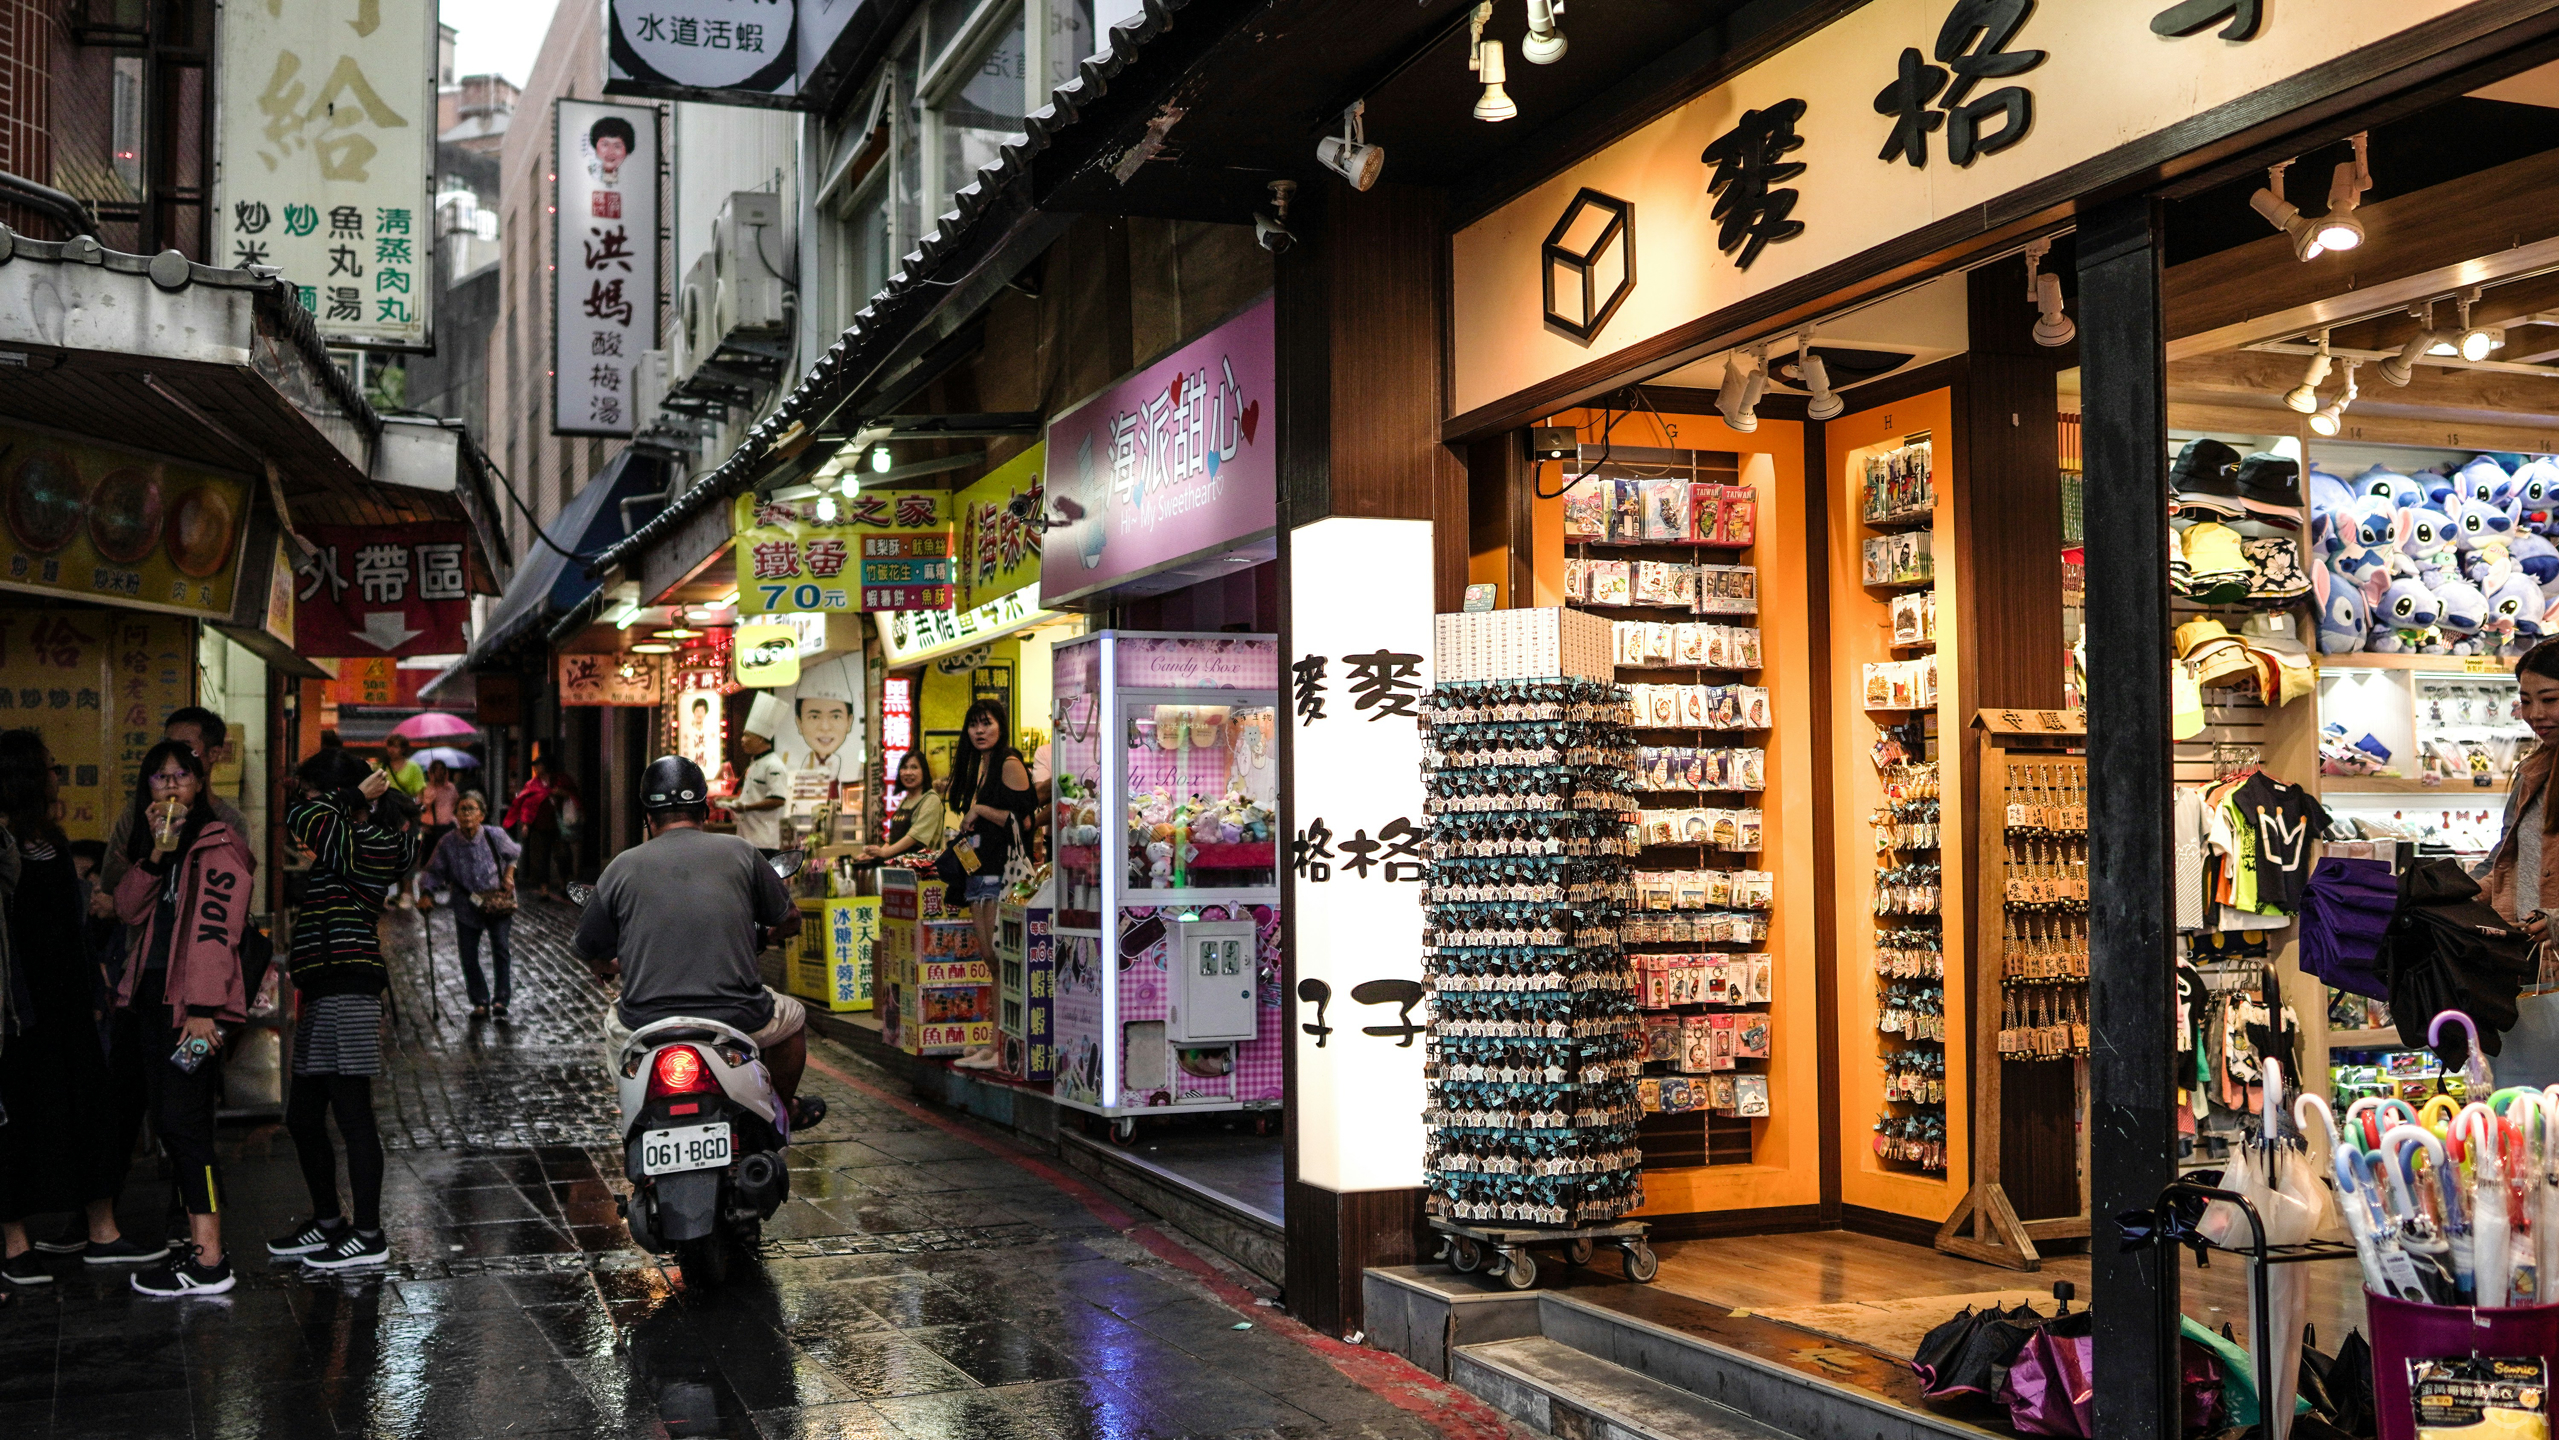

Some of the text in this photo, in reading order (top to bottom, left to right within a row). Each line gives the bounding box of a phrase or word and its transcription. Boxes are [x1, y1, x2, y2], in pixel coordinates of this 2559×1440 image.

[636, 13, 764, 53] 水道活蝦
[326, 205, 363, 321] 魚丸湯
[375, 207, 412, 323] 清蒸肉丸
[583, 224, 635, 328] 洪媽
[589, 330, 624, 425] 酸梅湯
[1106, 354, 1246, 510] 海派甜心
[1666, 423, 1678, 438] G
[1883, 414, 1893, 431] H
[2350, 427, 2362, 440] 14
[2447, 433, 2459, 446] 15
[2540, 440, 2552, 453] 16
[1696, 488, 1720, 497] TAIWAN
[1726, 490, 1752, 500] TAIWAN
[1140, 500, 1156, 533] My
[1158, 476, 1217, 522] Sweetheart
[752, 539, 848, 579] 鐵蛋
[300, 543, 466, 604] 外帶區
[1150, 655, 1241, 679] Candy Box
[1155, 765, 1204, 787] Box
[927, 964, 967, 981] 魚酥
[922, 1028, 966, 1045] 魚酥
